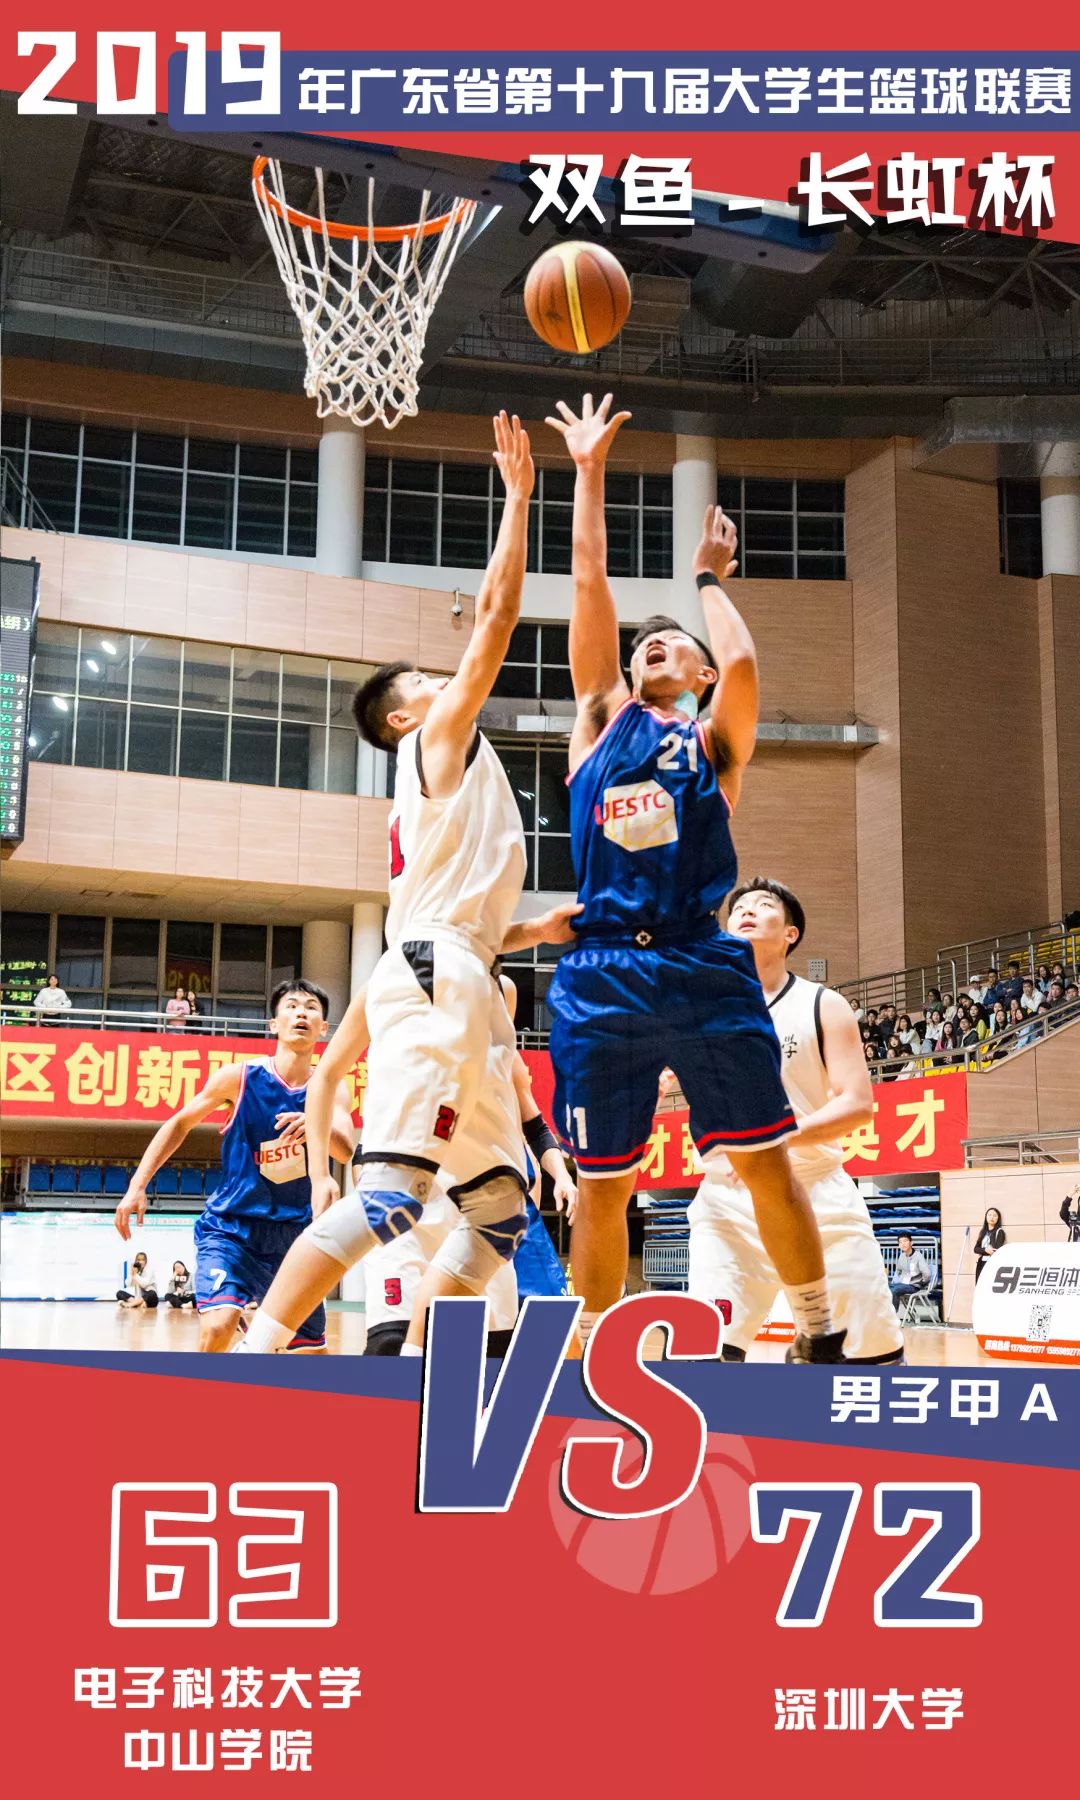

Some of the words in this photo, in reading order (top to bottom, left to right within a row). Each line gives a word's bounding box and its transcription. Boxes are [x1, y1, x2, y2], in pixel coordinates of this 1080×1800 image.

[657, 732, 698, 773] 21
[594, 789, 667, 825] UESTC
[0, 1041, 256, 1111] 区创新
[566, 1103, 588, 1150] 1
[253, 1143, 301, 1166] UESTC
[210, 1268, 227, 1291] 7
